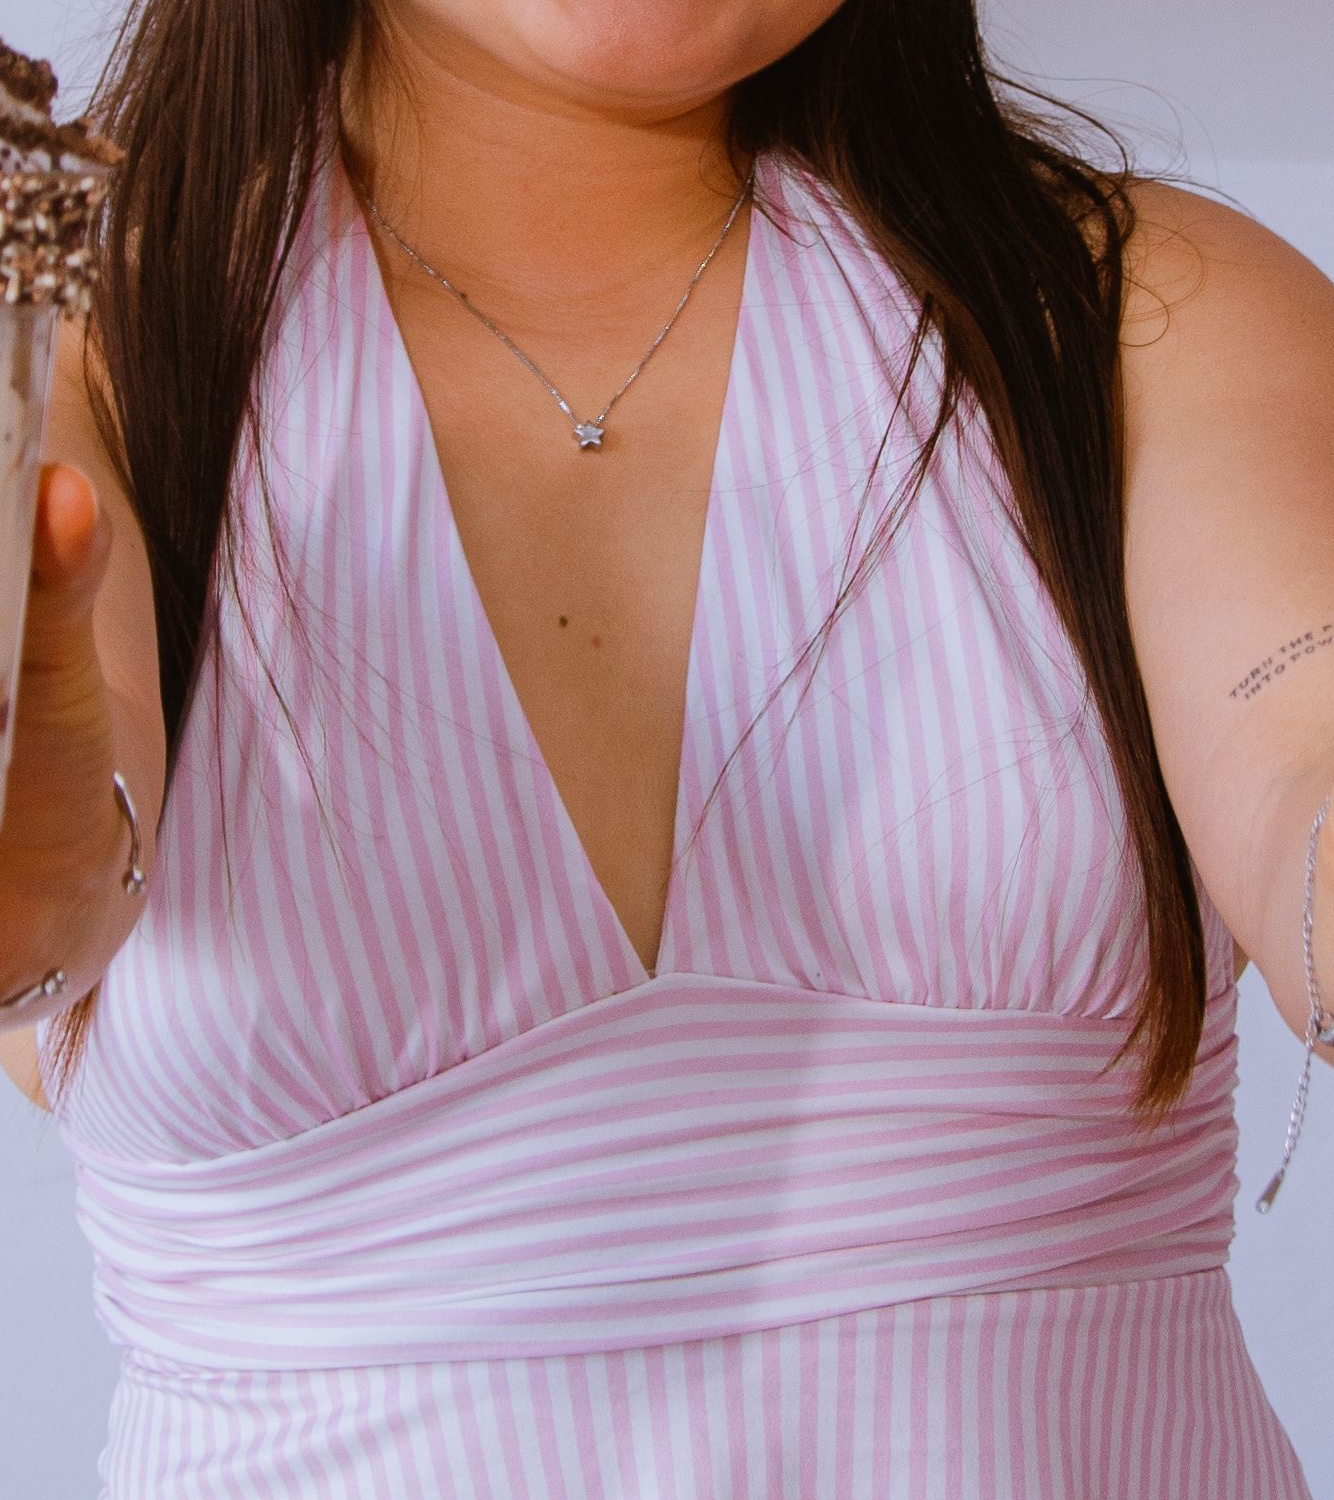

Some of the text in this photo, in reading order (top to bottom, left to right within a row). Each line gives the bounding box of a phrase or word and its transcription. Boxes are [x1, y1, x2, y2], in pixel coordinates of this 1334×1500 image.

[1229, 656, 1273, 698] TURN
[1278, 632, 1314, 654] THE
[1244, 664, 1285, 700] INTO
